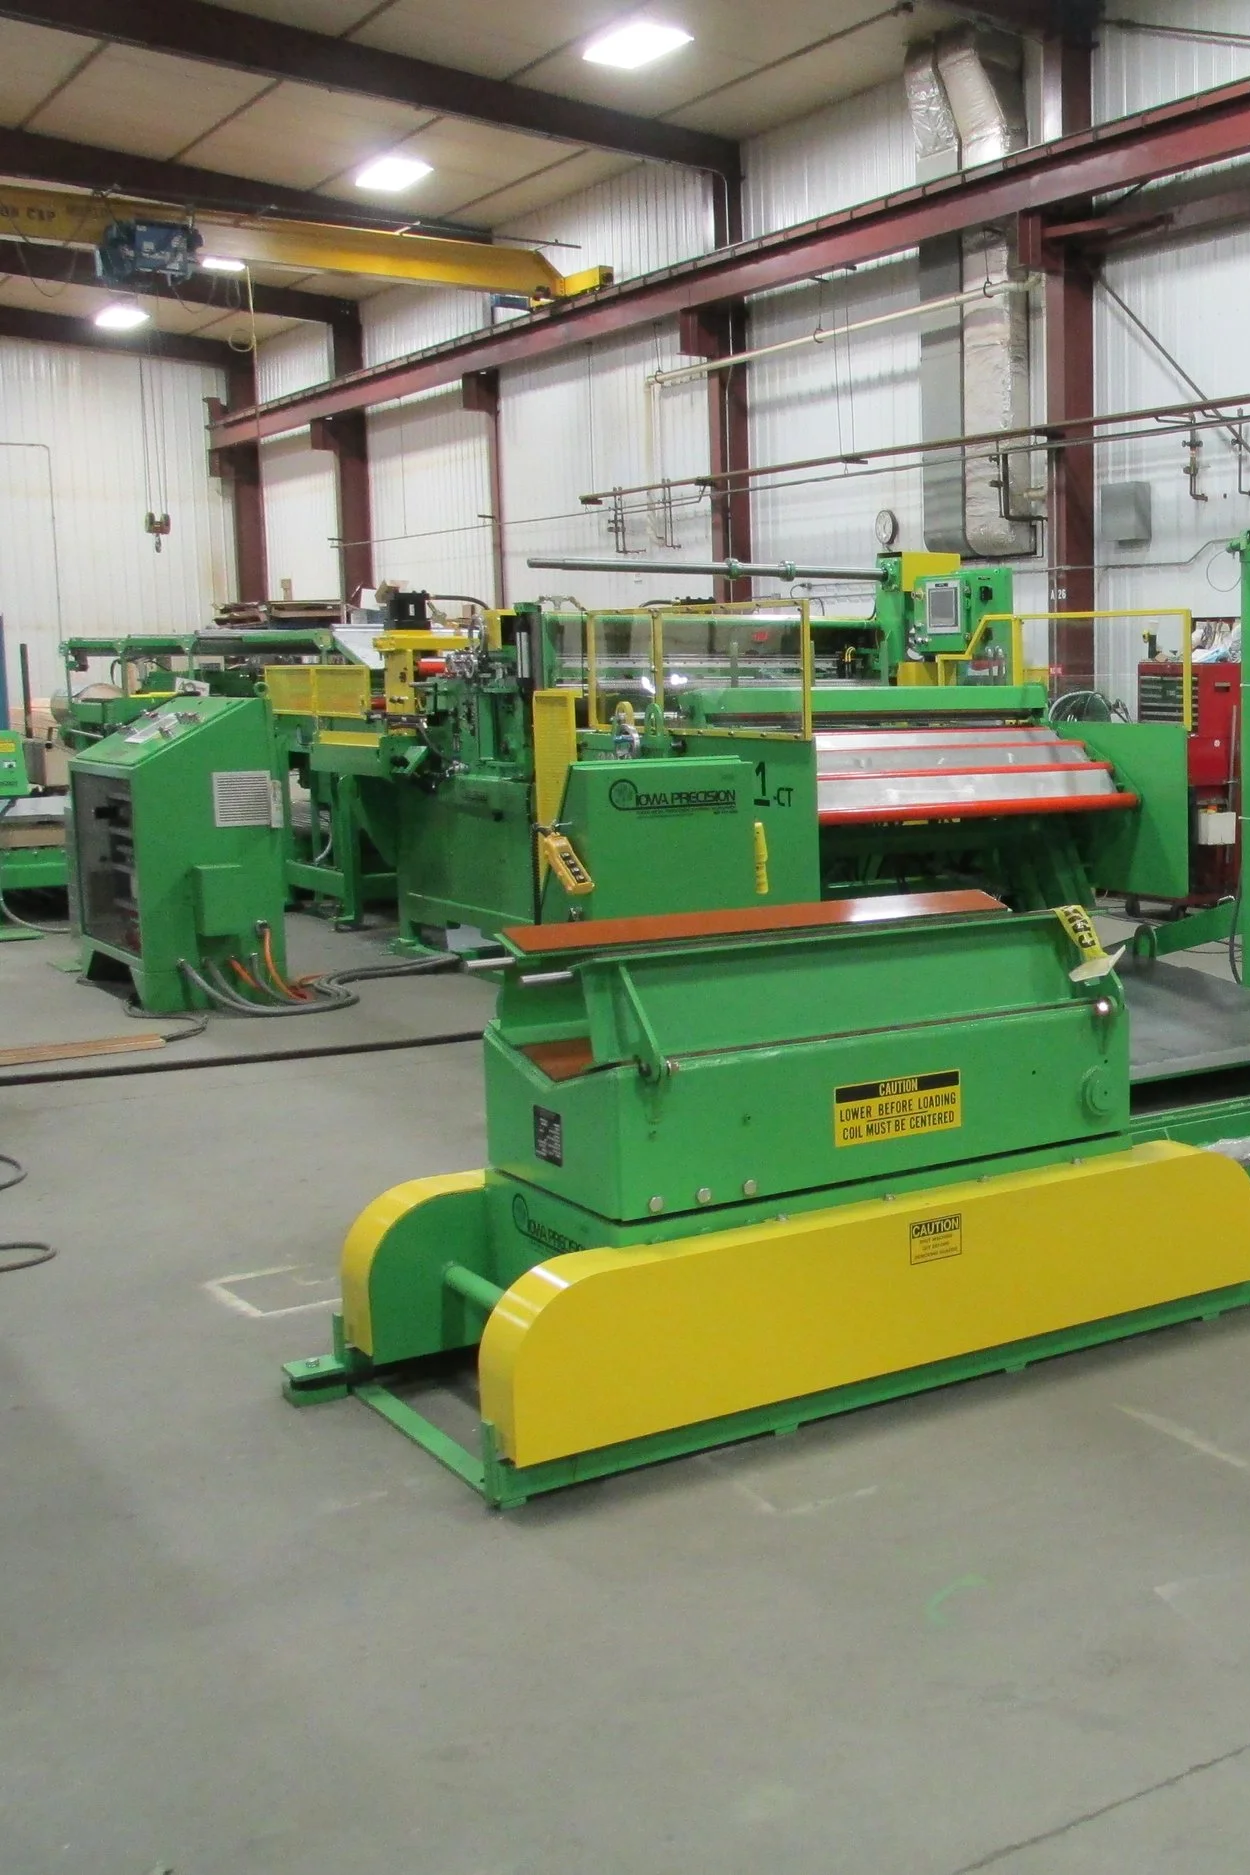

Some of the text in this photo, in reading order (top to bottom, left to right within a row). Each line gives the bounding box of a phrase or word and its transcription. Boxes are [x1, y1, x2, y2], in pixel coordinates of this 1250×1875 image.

[1058, 588, 1067, 600] 26
[635, 789, 736, 808] IOWA PRECISION
[879, 1078, 918, 1096] CAUTION
[840, 1092, 956, 1122] LOWER BEFORE LOADING
[842, 1110, 955, 1140] COIL MUST BE CENTERED
[912, 1217, 959, 1238] CAUTION
